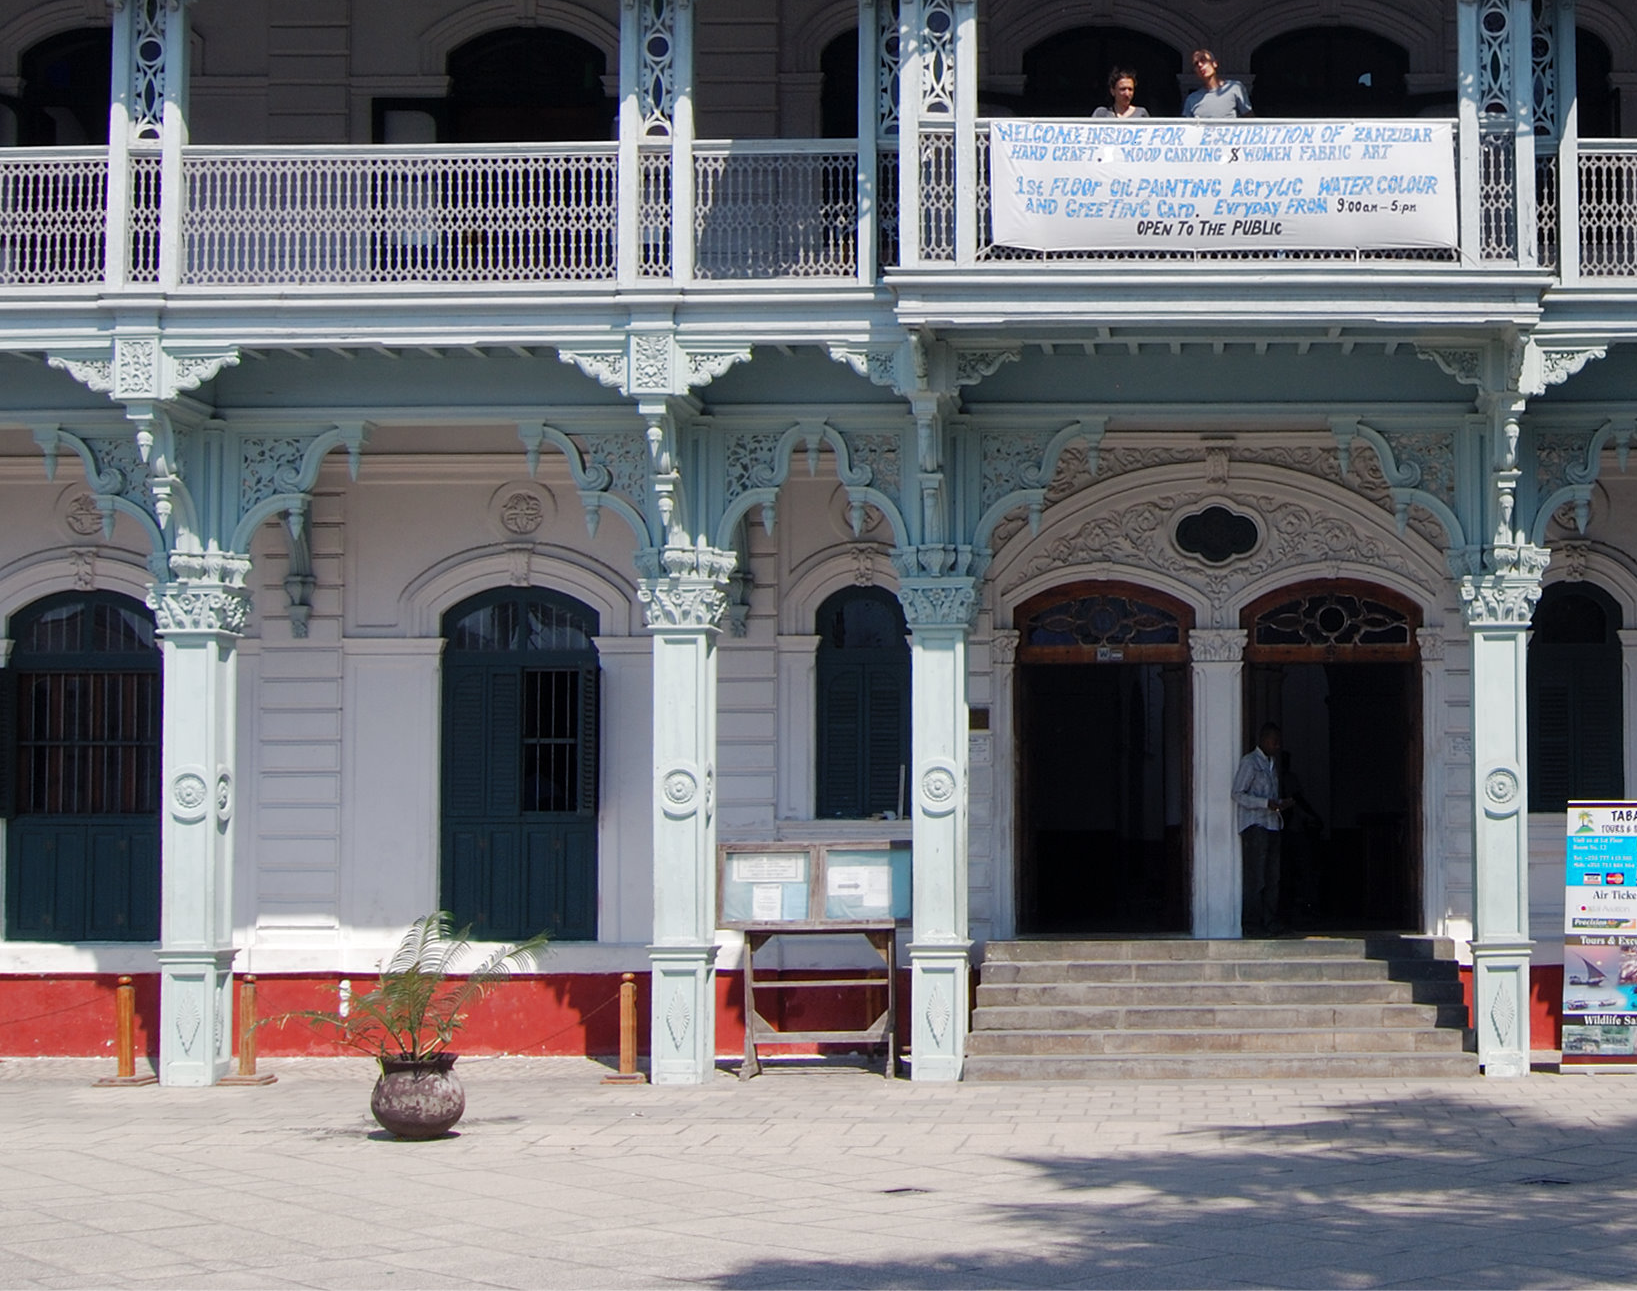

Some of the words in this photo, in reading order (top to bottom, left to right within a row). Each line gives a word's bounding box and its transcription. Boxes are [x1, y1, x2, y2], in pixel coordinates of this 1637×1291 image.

[997, 124, 1085, 144] WELCOME
[1087, 126, 1143, 146] INSIDE
[1149, 126, 1185, 146] FOR
[1201, 125, 1315, 145] EXHIBITION
[1320, 125, 1345, 143] OF
[1352, 127, 1432, 143] ZANZIBAR
[1010, 145, 1048, 161] HAND
[1121, 147, 1161, 162] WOOD
[1164, 147, 1222, 163] CARVING
[1243, 145, 1292, 162] WOMEN
[1300, 145, 1352, 162] FABRIC
[1360, 144, 1393, 160] ART
[1015, 175, 1044, 196] 1st
[1318, 176, 1374, 196] WATER
[1376, 175, 1438, 195] COLOUR
[1025, 197, 1058, 216] AND
[1284, 197, 1328, 215] FROM
[1137, 220, 1173, 236] OPEN
[1199, 220, 1227, 236] THE
[1231, 219, 1282, 236] PUBLIC
[1601, 824, 1625, 834] TOURS
[1593, 890, 1608, 900] Air
[1580, 935, 1605, 945] Tours
[1607, 935, 1615, 945] &
[1584, 1015, 1622, 1025] Wildlife
